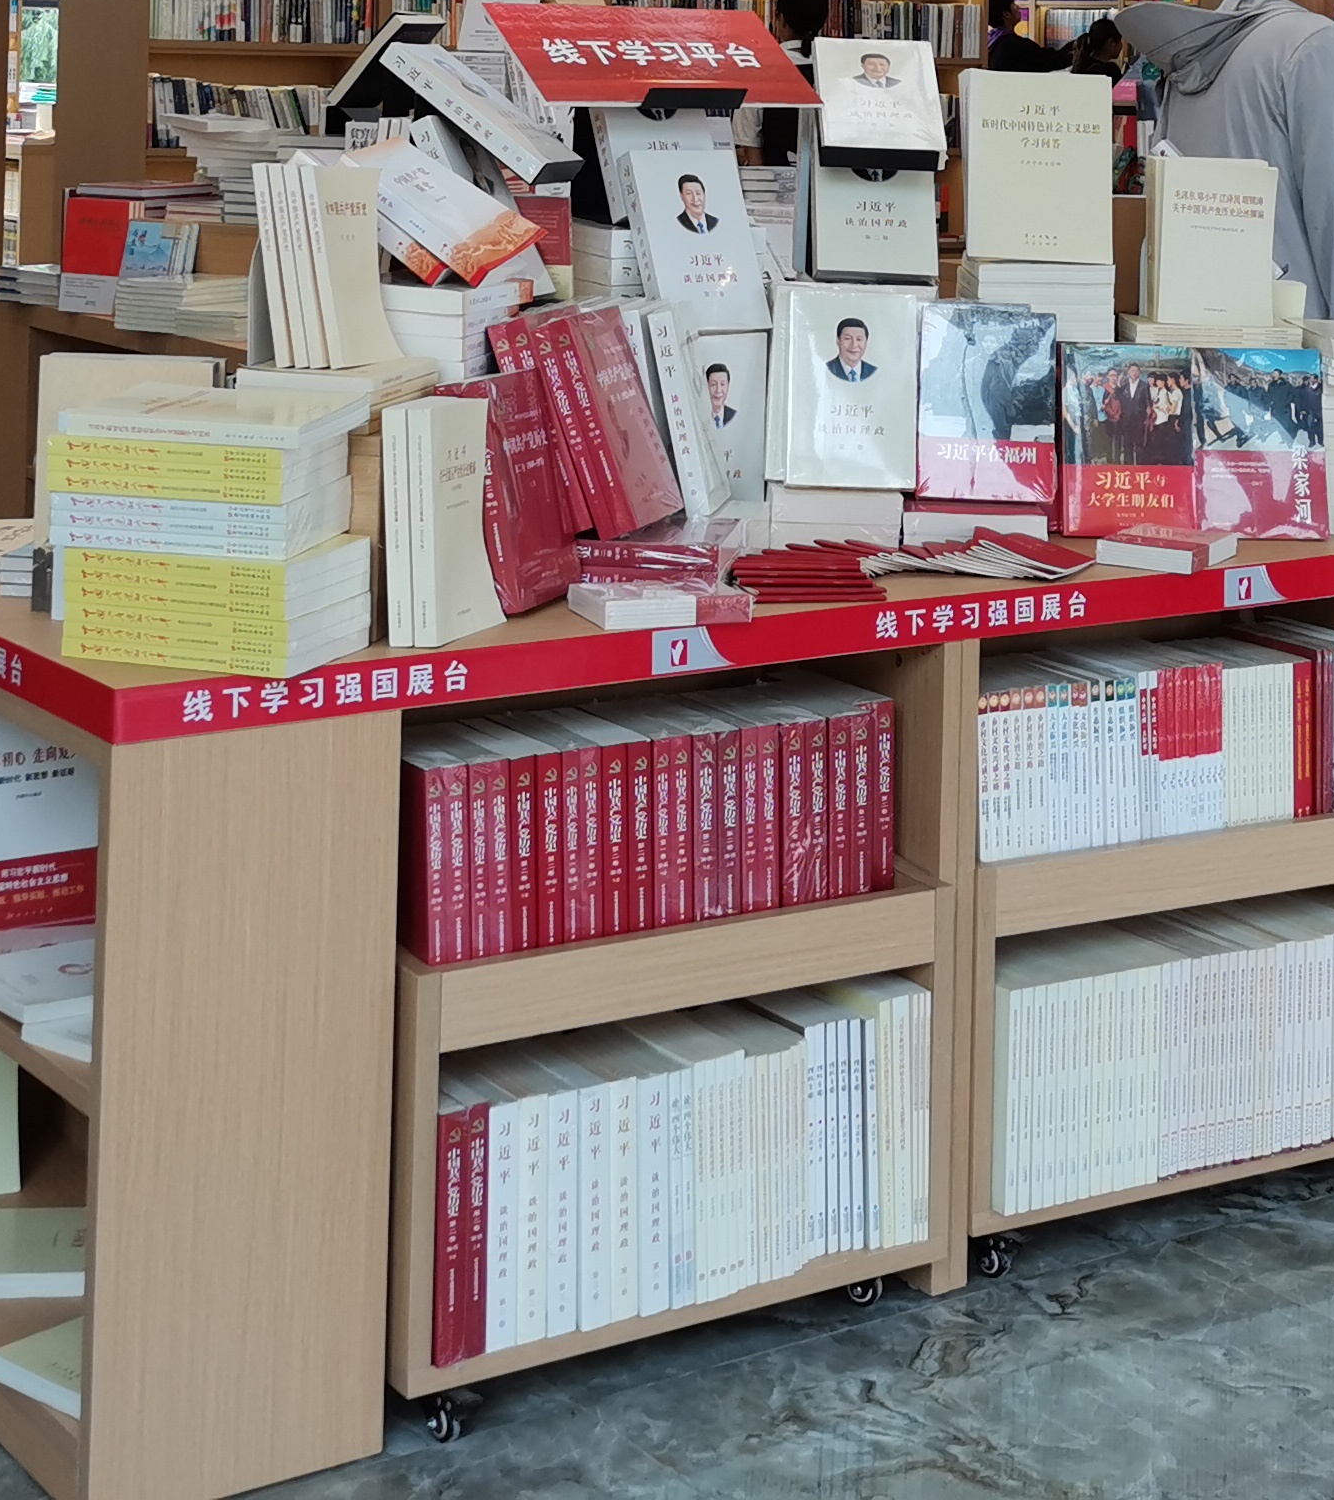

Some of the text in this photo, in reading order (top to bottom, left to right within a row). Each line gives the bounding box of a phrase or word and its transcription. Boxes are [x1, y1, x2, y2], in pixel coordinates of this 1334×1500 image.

[542, 36, 763, 70] 线下学习平台
[981, 117, 1101, 135] 新时代中国特色社会主义思想
[1018, 104, 1062, 116] 习近平
[1020, 137, 1062, 150] 学习问答
[844, 217, 909, 229] 谈治国理政
[855, 200, 897, 213] 习近平
[689, 253, 725, 267] 习近平
[655, 320, 677, 378] 习近平
[830, 403, 875, 418] 习近平
[936, 443, 1037, 465] 习近平在福州
[1087, 491, 1176, 509] 大学生朋友们
[1291, 443, 1313, 525] 梁家河
[875, 591, 1089, 641] 线下学习强国展台
[182, 660, 471, 724] 线下学习强国展台
[557, 1108, 571, 1172] 习近平
[588, 1097, 602, 1161] 习近平
[617, 1094, 631, 1157] 习近平
[649, 1090, 662, 1154] 习近平
[498, 1120, 512, 1185] 习近平
[526, 1112, 540, 1177] 习近平
